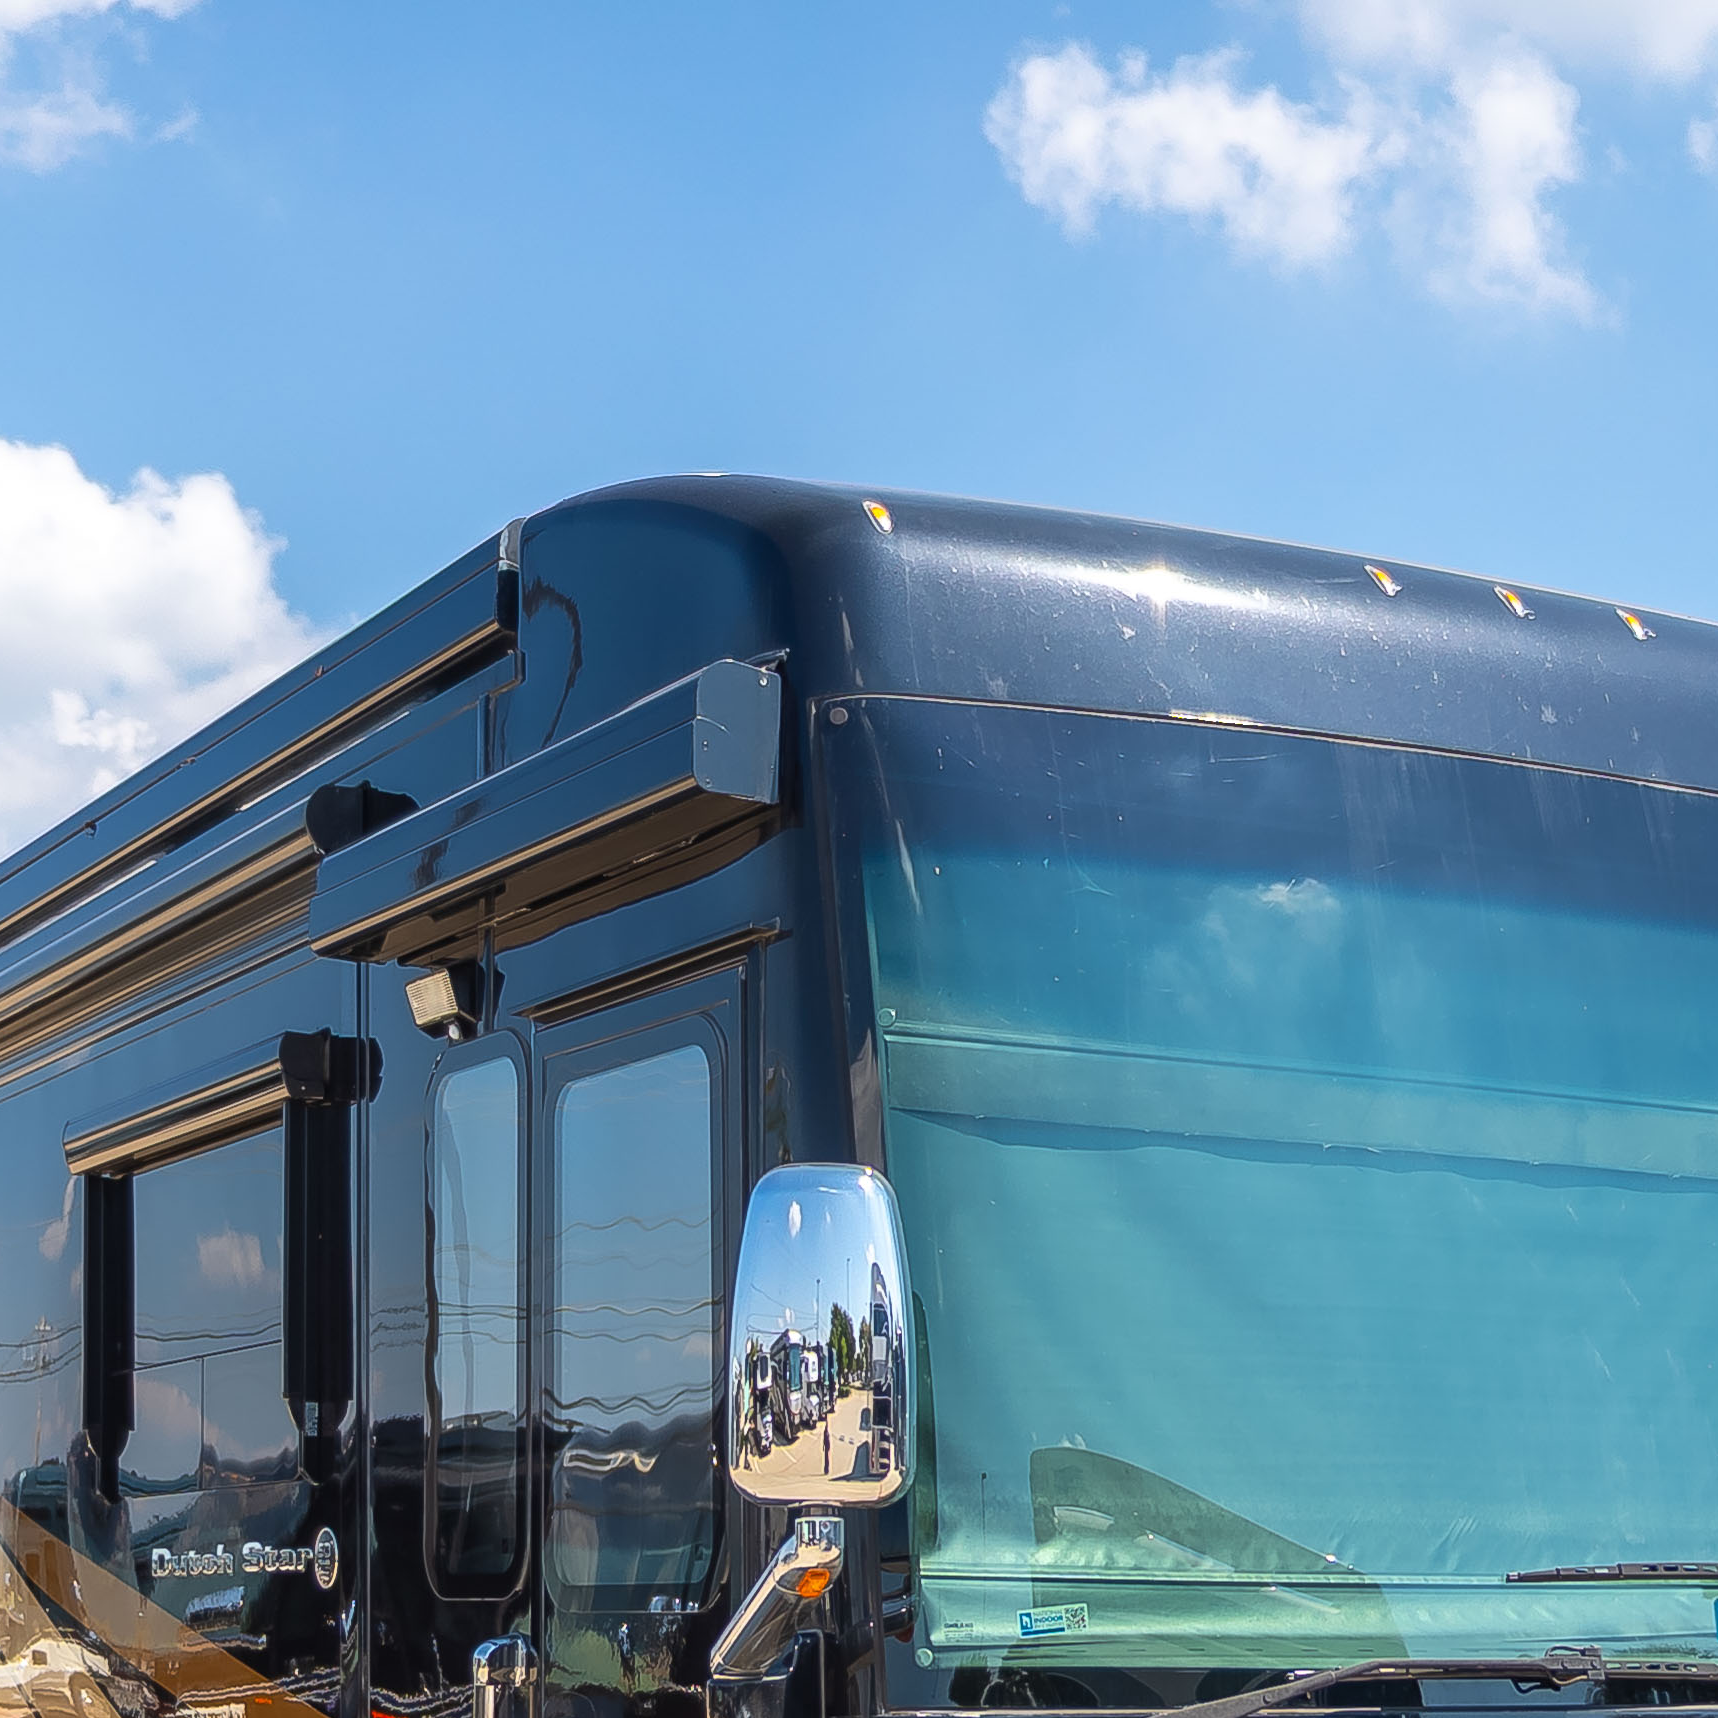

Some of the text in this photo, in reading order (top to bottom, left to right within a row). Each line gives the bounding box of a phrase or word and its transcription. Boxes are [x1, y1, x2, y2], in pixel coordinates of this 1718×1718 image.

[151, 1543, 234, 1578] Dutch
[241, 1541, 314, 1573] Star
[1033, 1614, 1064, 1624] INDOOR
